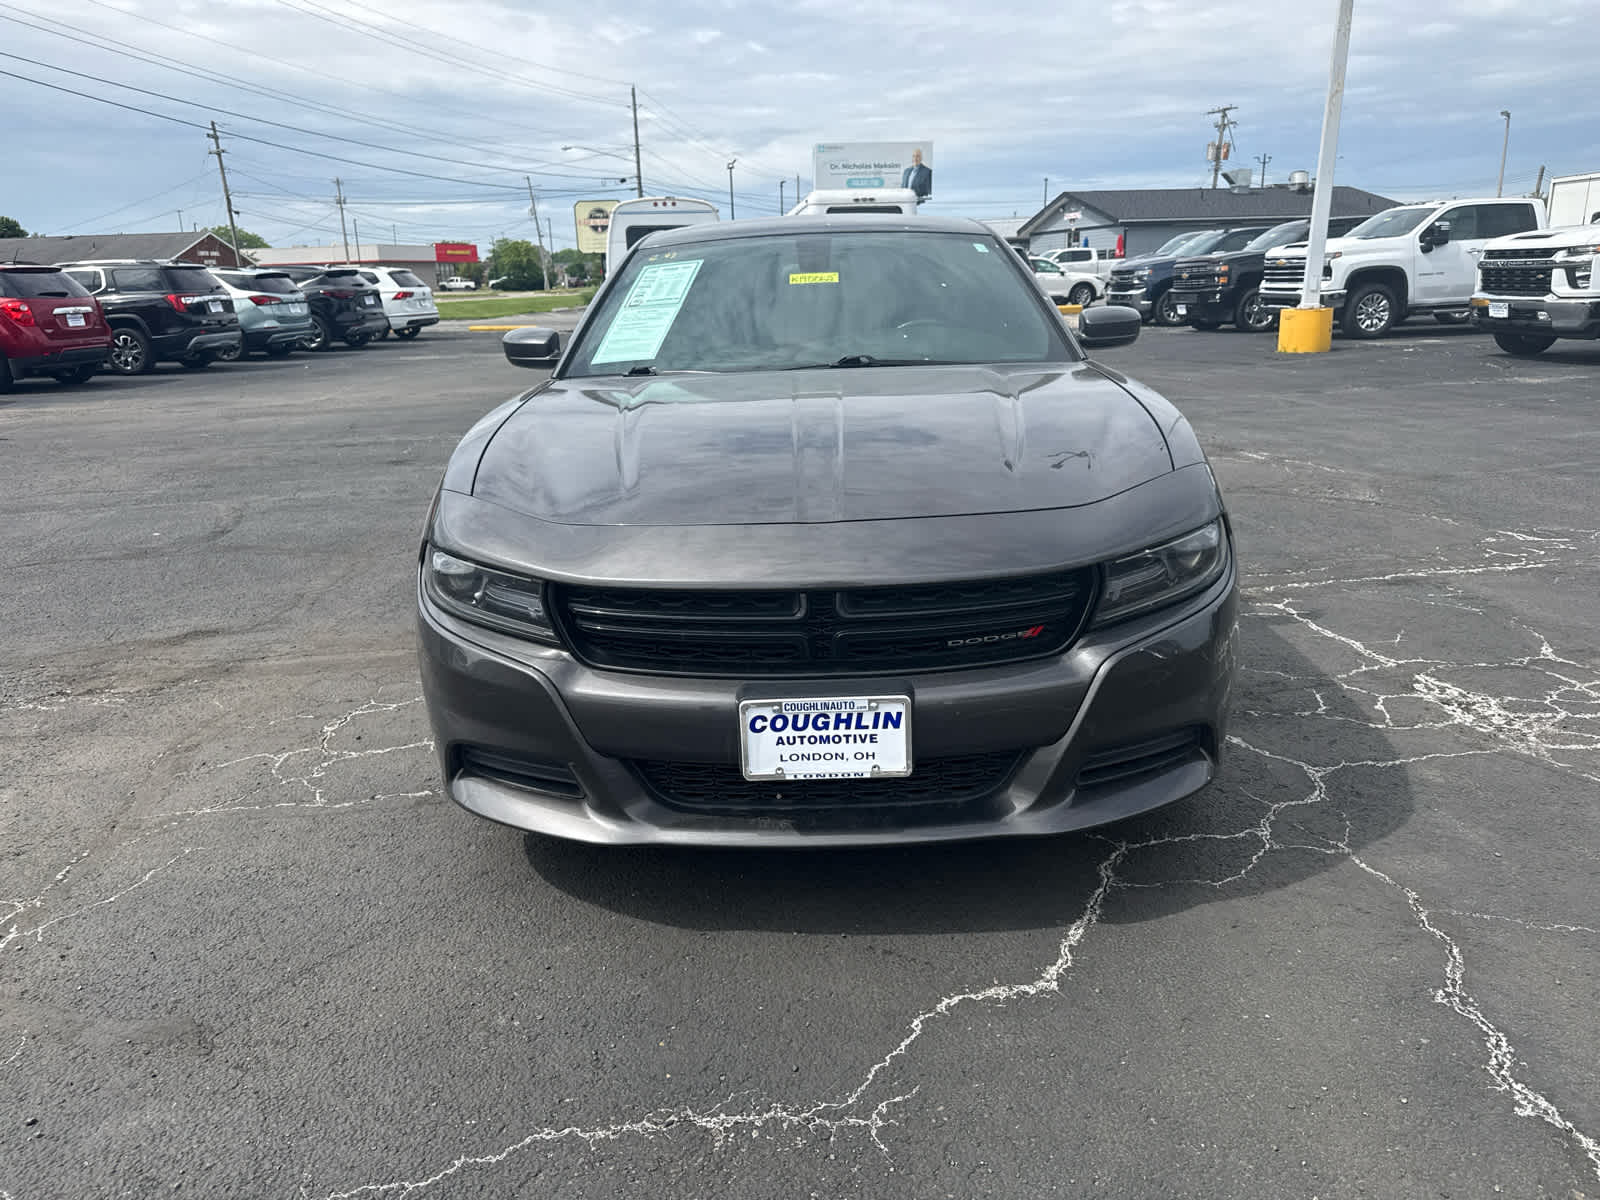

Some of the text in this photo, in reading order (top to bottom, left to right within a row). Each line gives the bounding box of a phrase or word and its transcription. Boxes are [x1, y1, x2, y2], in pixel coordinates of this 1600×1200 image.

[947, 630, 1034, 647] DODGE
[749, 711, 903, 734] COUGHLIN
[775, 733, 879, 746] AUTOMOTIVE
[780, 751, 876, 762] LONDON, OH
